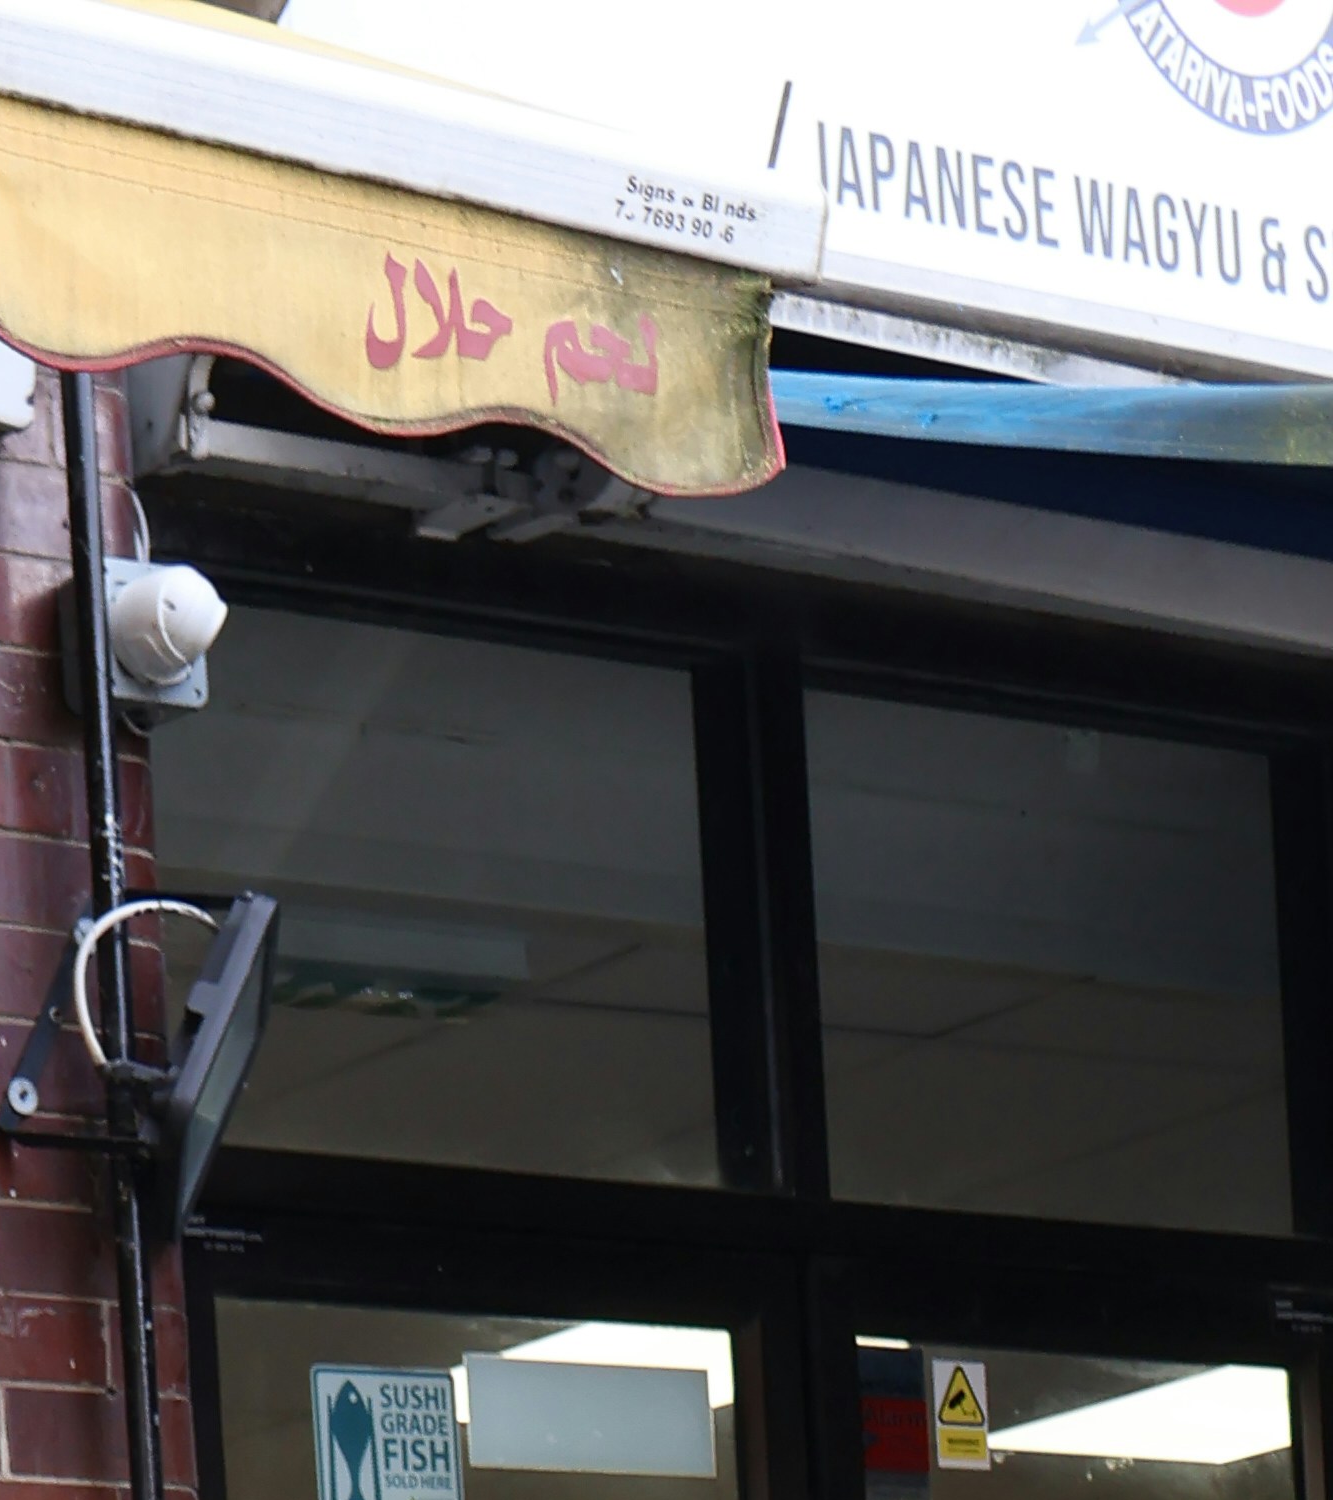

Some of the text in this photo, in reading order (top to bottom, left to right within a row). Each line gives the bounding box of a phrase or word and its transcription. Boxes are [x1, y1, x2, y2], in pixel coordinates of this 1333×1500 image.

[1073, 174, 1241, 285] WAGYU
[1259, 216, 1287, 296] &
[1303, 225, 1333, 304] S
[366, 250, 659, 407] لحم حلال
[379, 1384, 446, 1410] SUSHI
[380, 1413, 449, 1436] GRADE
[383, 1438, 450, 1472] FISH
[385, 1475, 420, 1488] SOLD
